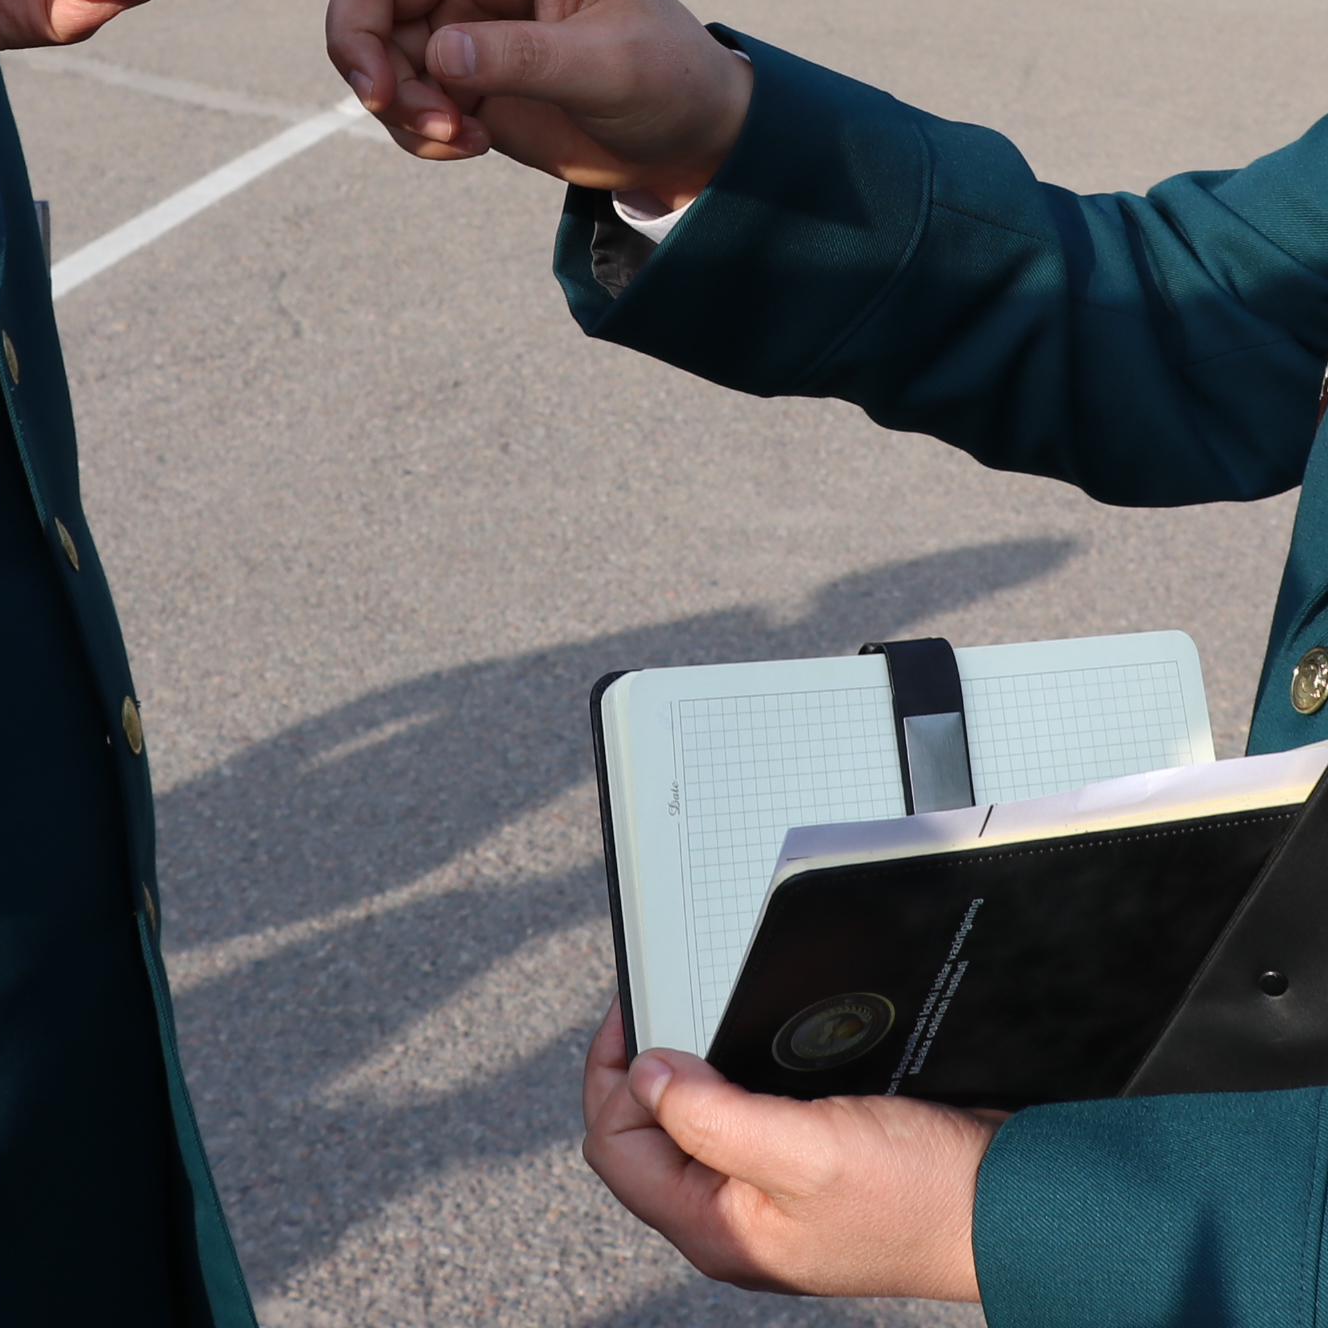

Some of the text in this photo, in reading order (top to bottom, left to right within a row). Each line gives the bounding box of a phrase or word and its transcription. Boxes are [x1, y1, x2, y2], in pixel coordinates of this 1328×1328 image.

[667, 779, 680, 817] Date
[892, 1014, 928, 1079] Respublikasi
[947, 897, 984, 961] vazirligining
